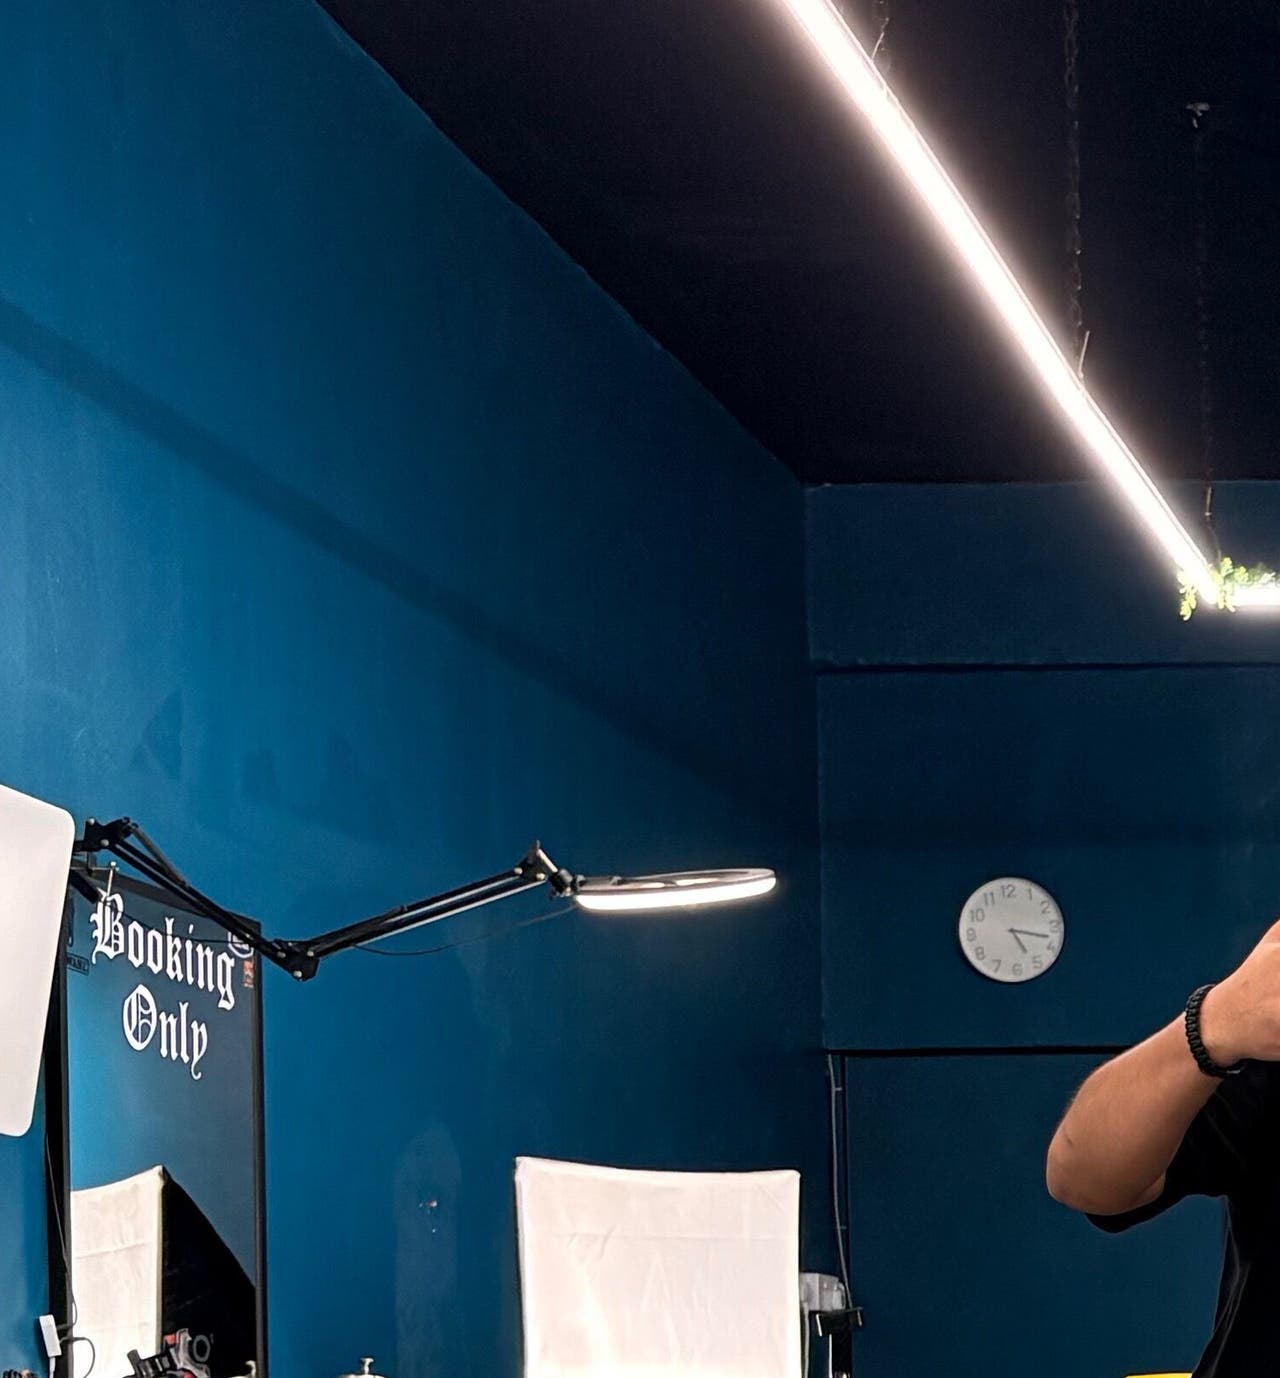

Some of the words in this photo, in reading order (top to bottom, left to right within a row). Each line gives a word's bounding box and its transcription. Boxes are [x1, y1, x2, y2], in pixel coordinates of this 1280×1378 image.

[1001, 884, 1016, 898] 12
[984, 892, 995, 906] 11
[970, 908, 985, 922] 10
[90, 888, 235, 1011] Booking
[975, 946, 985, 960] 8
[992, 959, 1001, 973] 7
[123, 984, 208, 1080] Only
